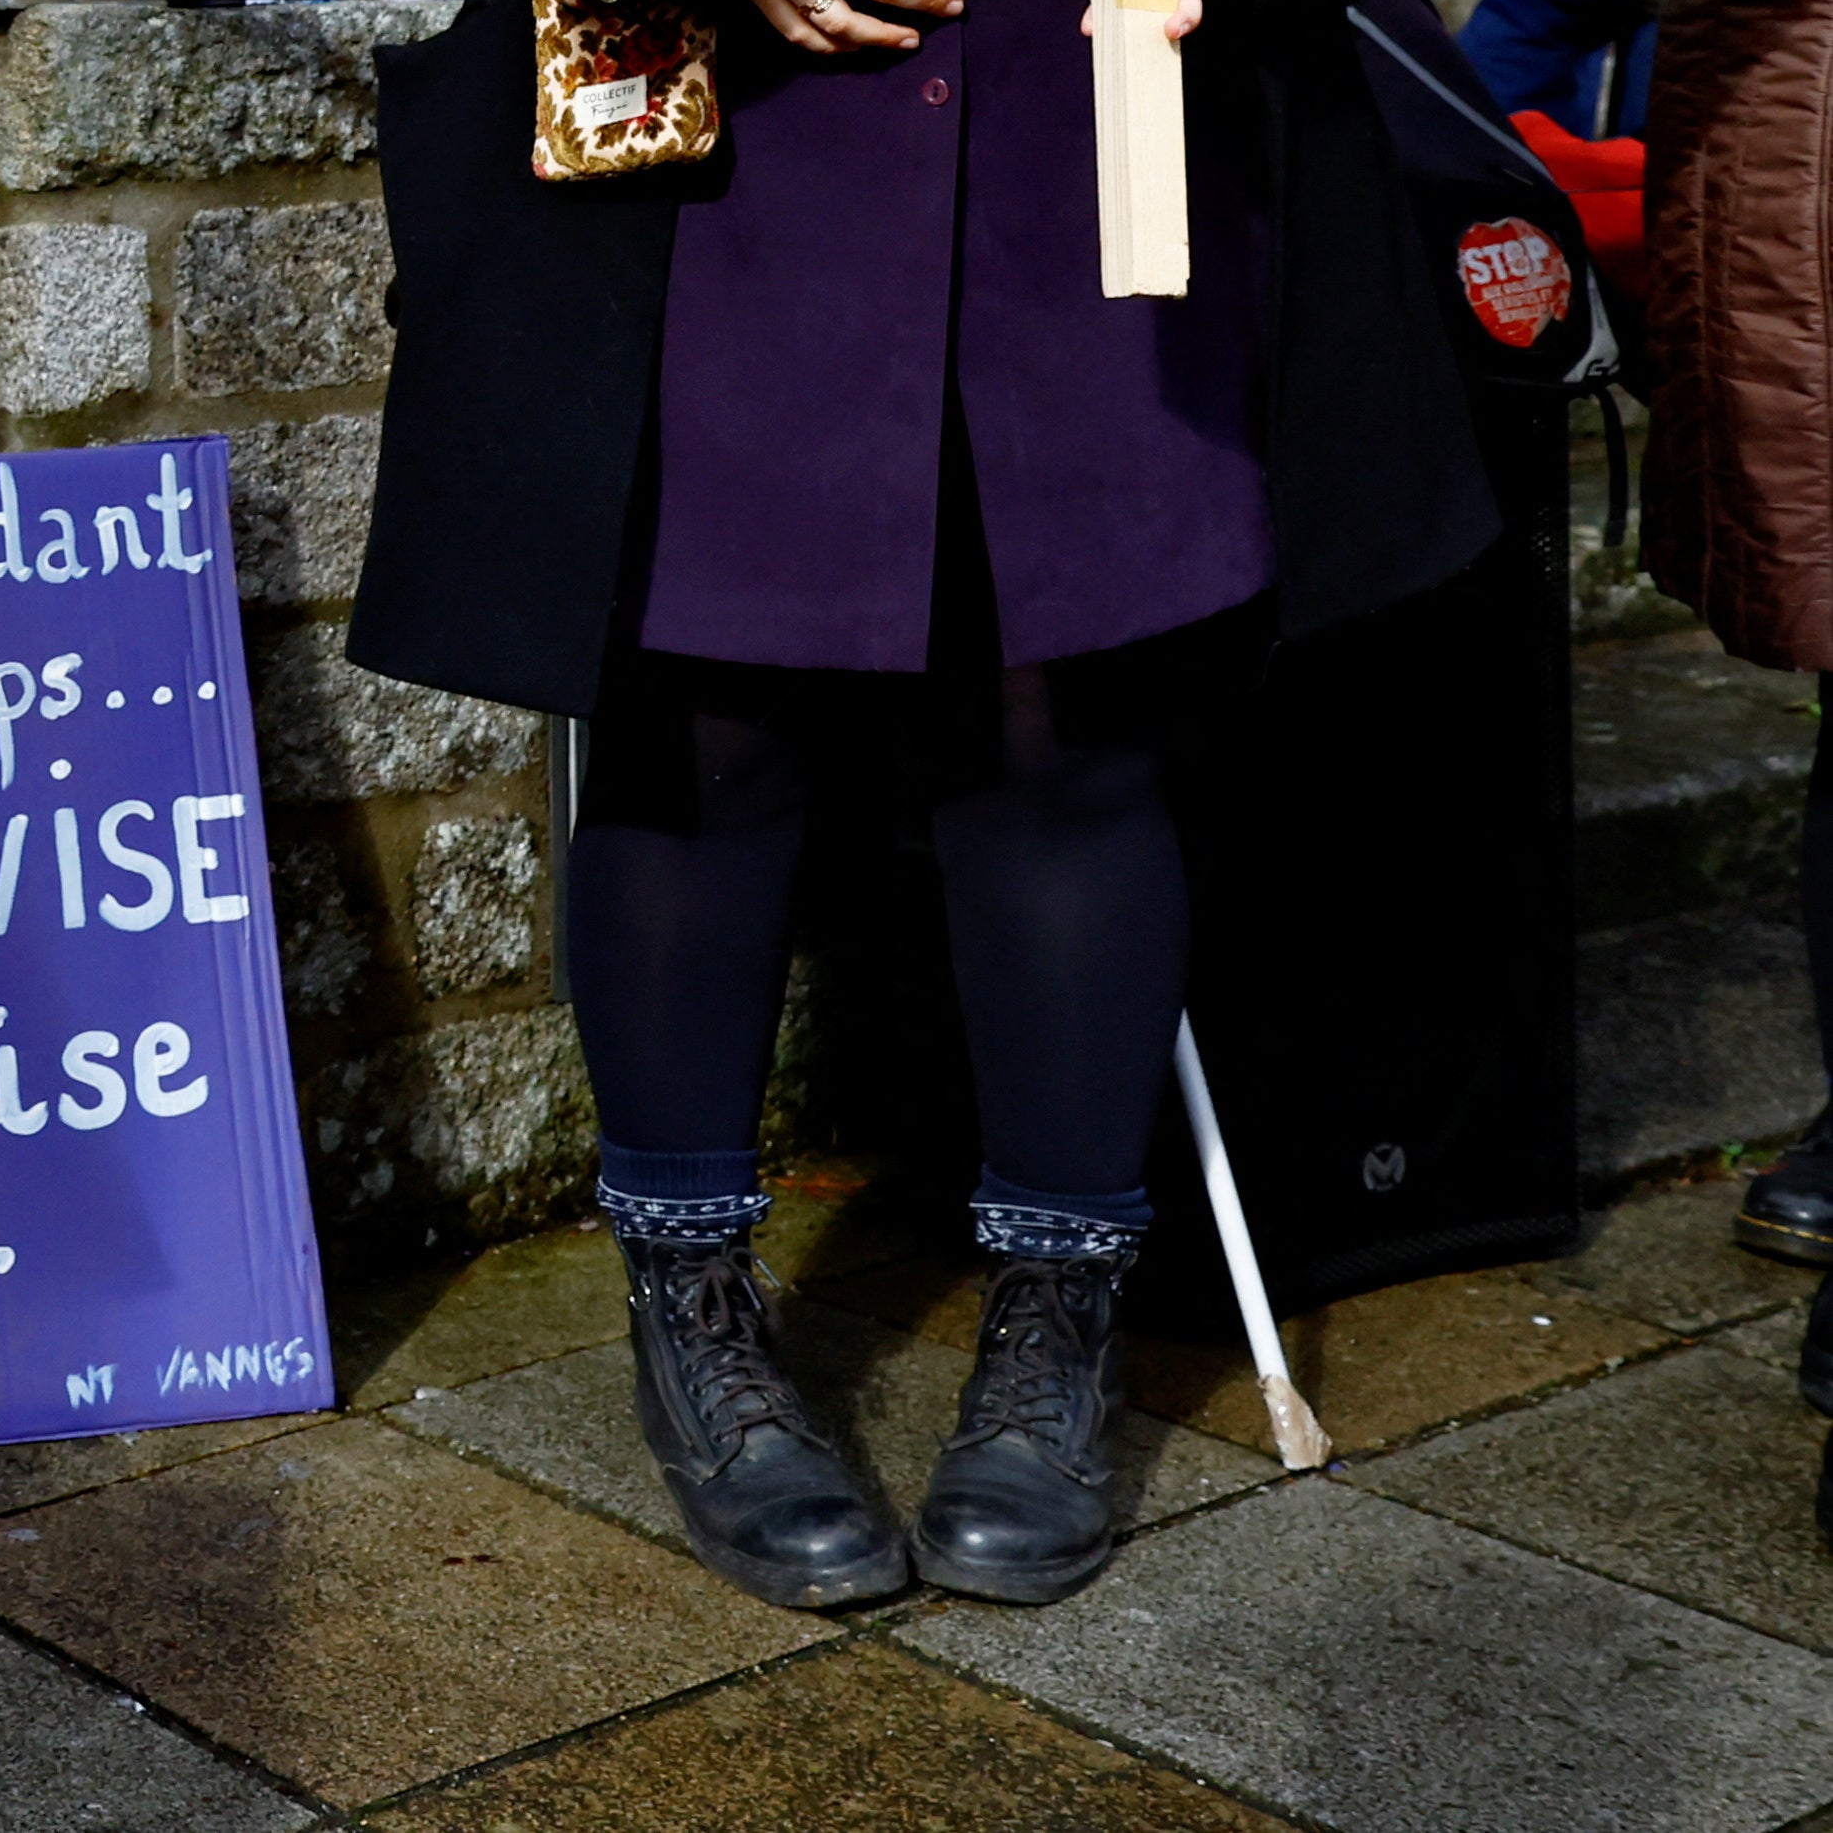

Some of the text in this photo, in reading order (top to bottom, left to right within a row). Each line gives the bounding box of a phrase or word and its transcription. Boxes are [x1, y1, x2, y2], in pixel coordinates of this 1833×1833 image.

[1464, 237, 1550, 284] STOP
[66, 1337, 315, 1409] NT VANNES
